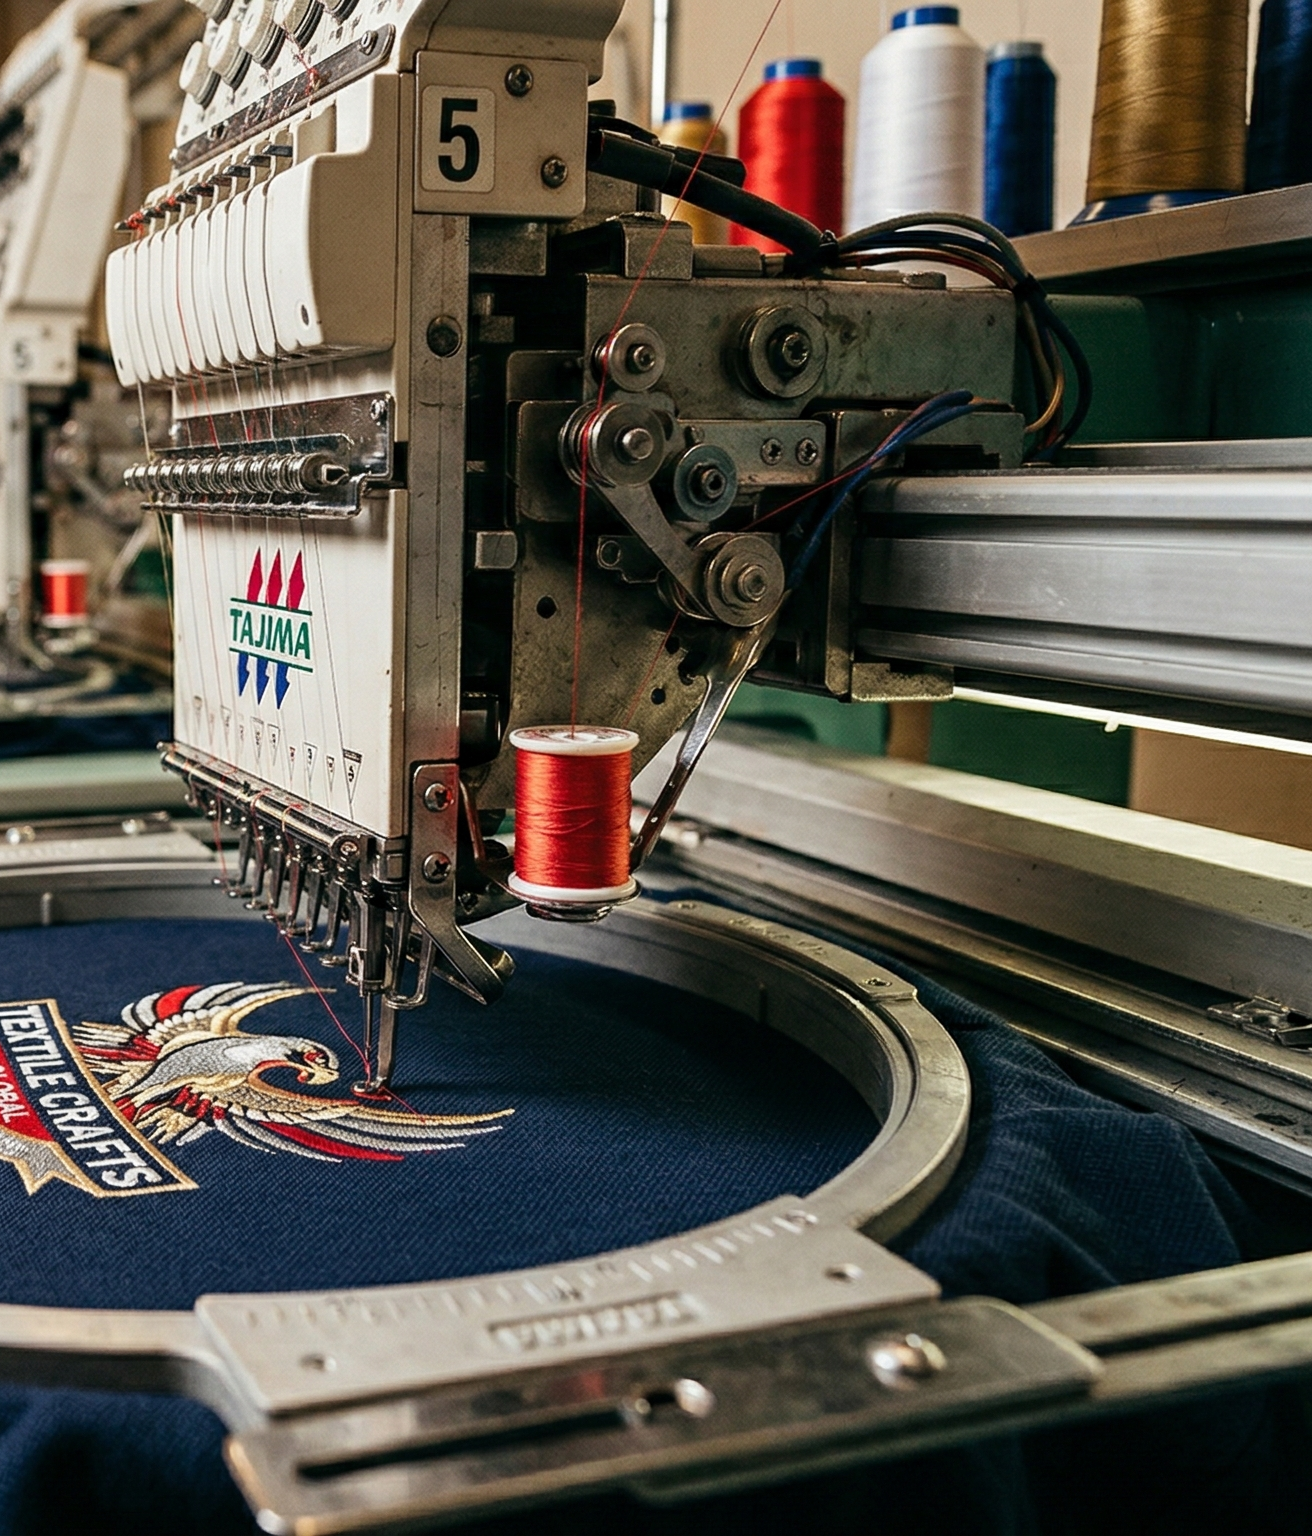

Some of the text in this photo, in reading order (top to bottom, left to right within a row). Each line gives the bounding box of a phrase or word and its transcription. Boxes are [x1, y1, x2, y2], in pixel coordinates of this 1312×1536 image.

[438, 98, 480, 182] 5
[230, 608, 311, 660] TAJIMA
[38, 1092, 162, 1187] CRAFTS
